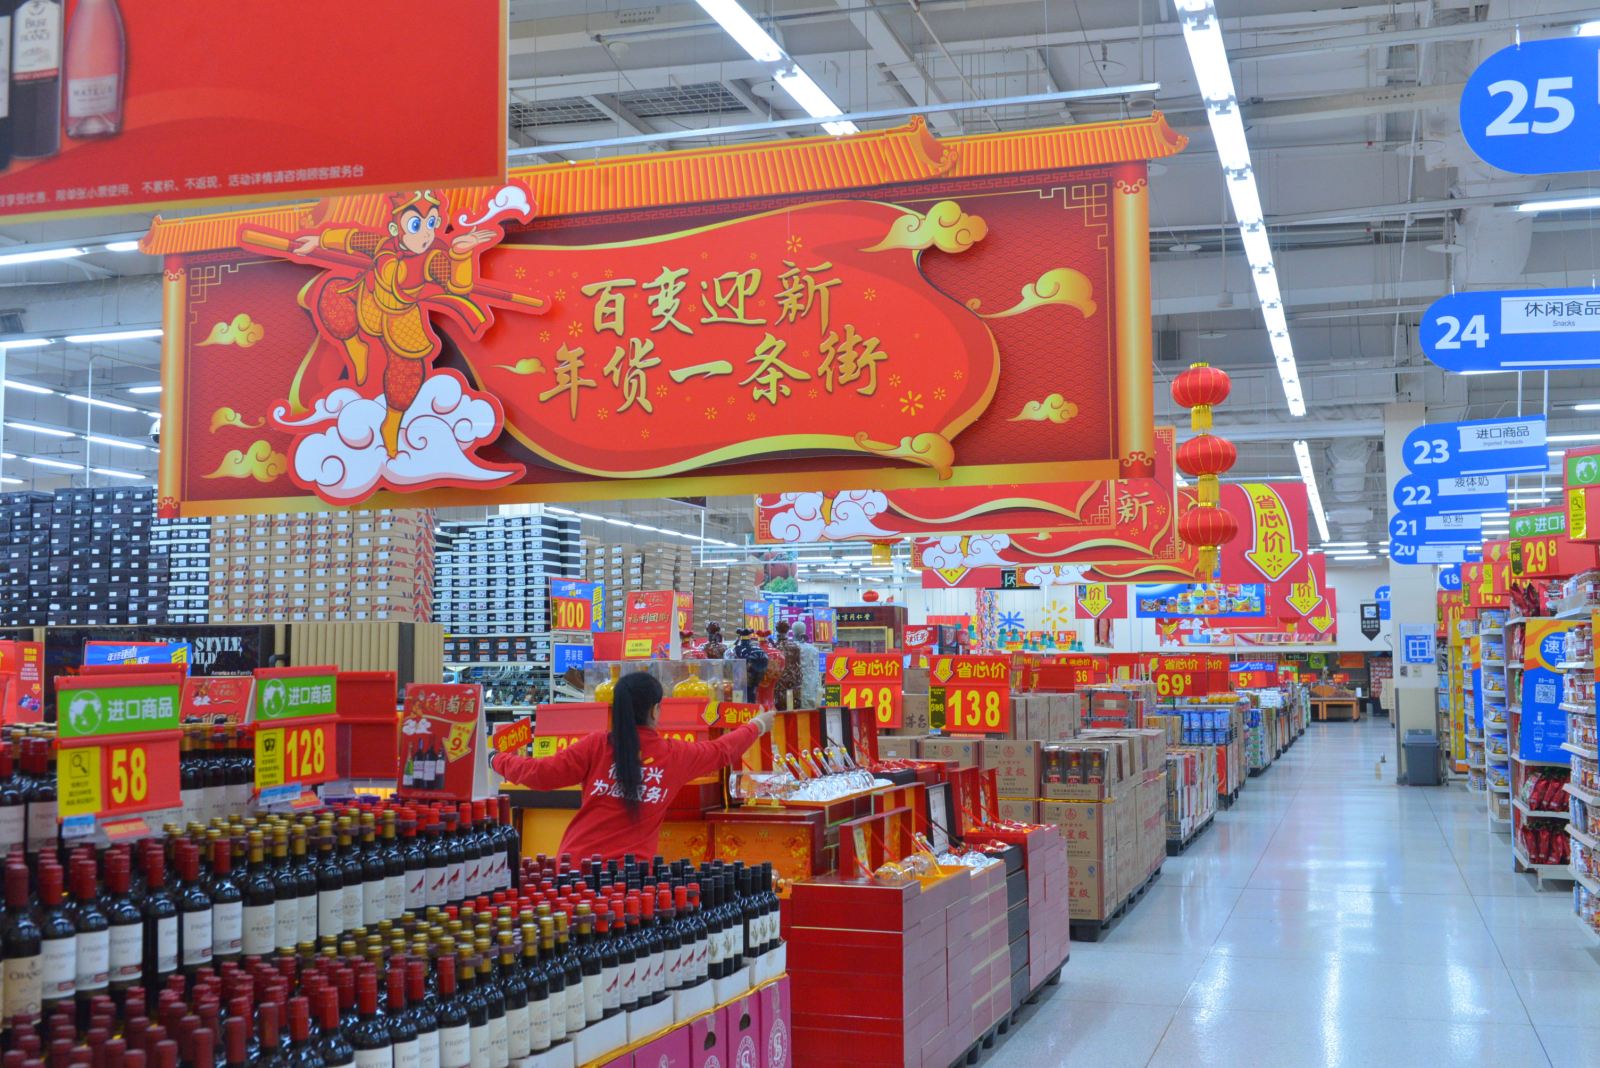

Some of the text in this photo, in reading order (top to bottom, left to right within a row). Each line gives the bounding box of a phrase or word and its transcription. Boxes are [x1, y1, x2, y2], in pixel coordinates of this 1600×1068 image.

[1486, 76, 1575, 137] 25
[581, 259, 842, 336] 百变迎新
[1524, 300, 1600, 318] 休闲食品
[1435, 314, 1490, 350] 24
[1552, 319, 1576, 328] Snacks
[538, 324, 889, 420] 年货一条街
[1476, 425, 1530, 439] 进口商品
[1413, 439, 1450, 465] 23
[1402, 485, 1432, 505] 22
[1454, 476, 1490, 488] 液体奶
[1117, 490, 1154, 532] 新
[1255, 494, 1287, 554] 省心价
[1395, 520, 1417, 536] 21
[1443, 574, 1460, 585] 18
[560, 601, 584, 628] 100
[195, 637, 242, 656] STYLE
[852, 659, 900, 677] 省心价
[957, 661, 1006, 679] 省心价
[1076, 670, 1088, 682] 36
[288, 684, 332, 706] 进口商品
[107, 696, 173, 722] 进口商品
[949, 690, 1001, 727] 138
[498, 725, 528, 752] 省心价
[287, 728, 325, 778] 128
[111, 747, 147, 804] 58
